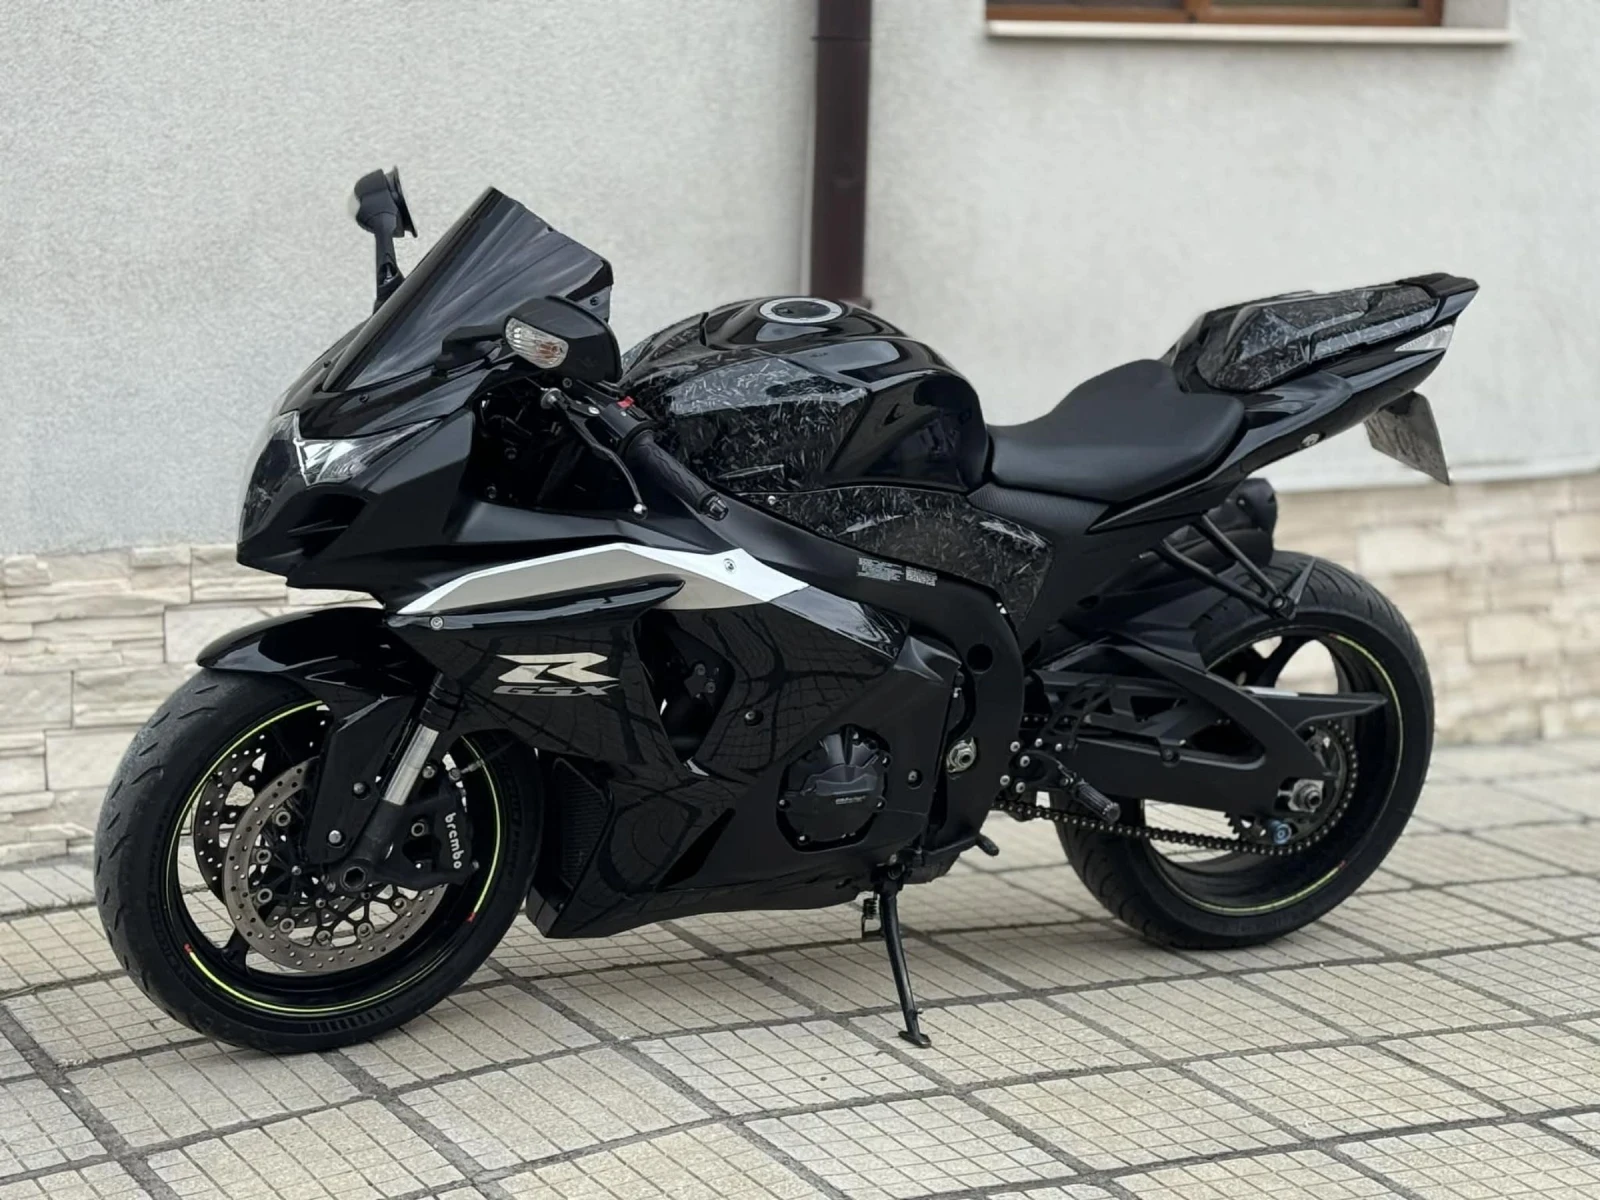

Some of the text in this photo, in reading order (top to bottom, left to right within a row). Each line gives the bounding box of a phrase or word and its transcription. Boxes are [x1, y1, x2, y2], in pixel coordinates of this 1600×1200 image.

[496, 652, 620, 683] R
[493, 684, 619, 697] GSX
[444, 812, 465, 869] brembo
